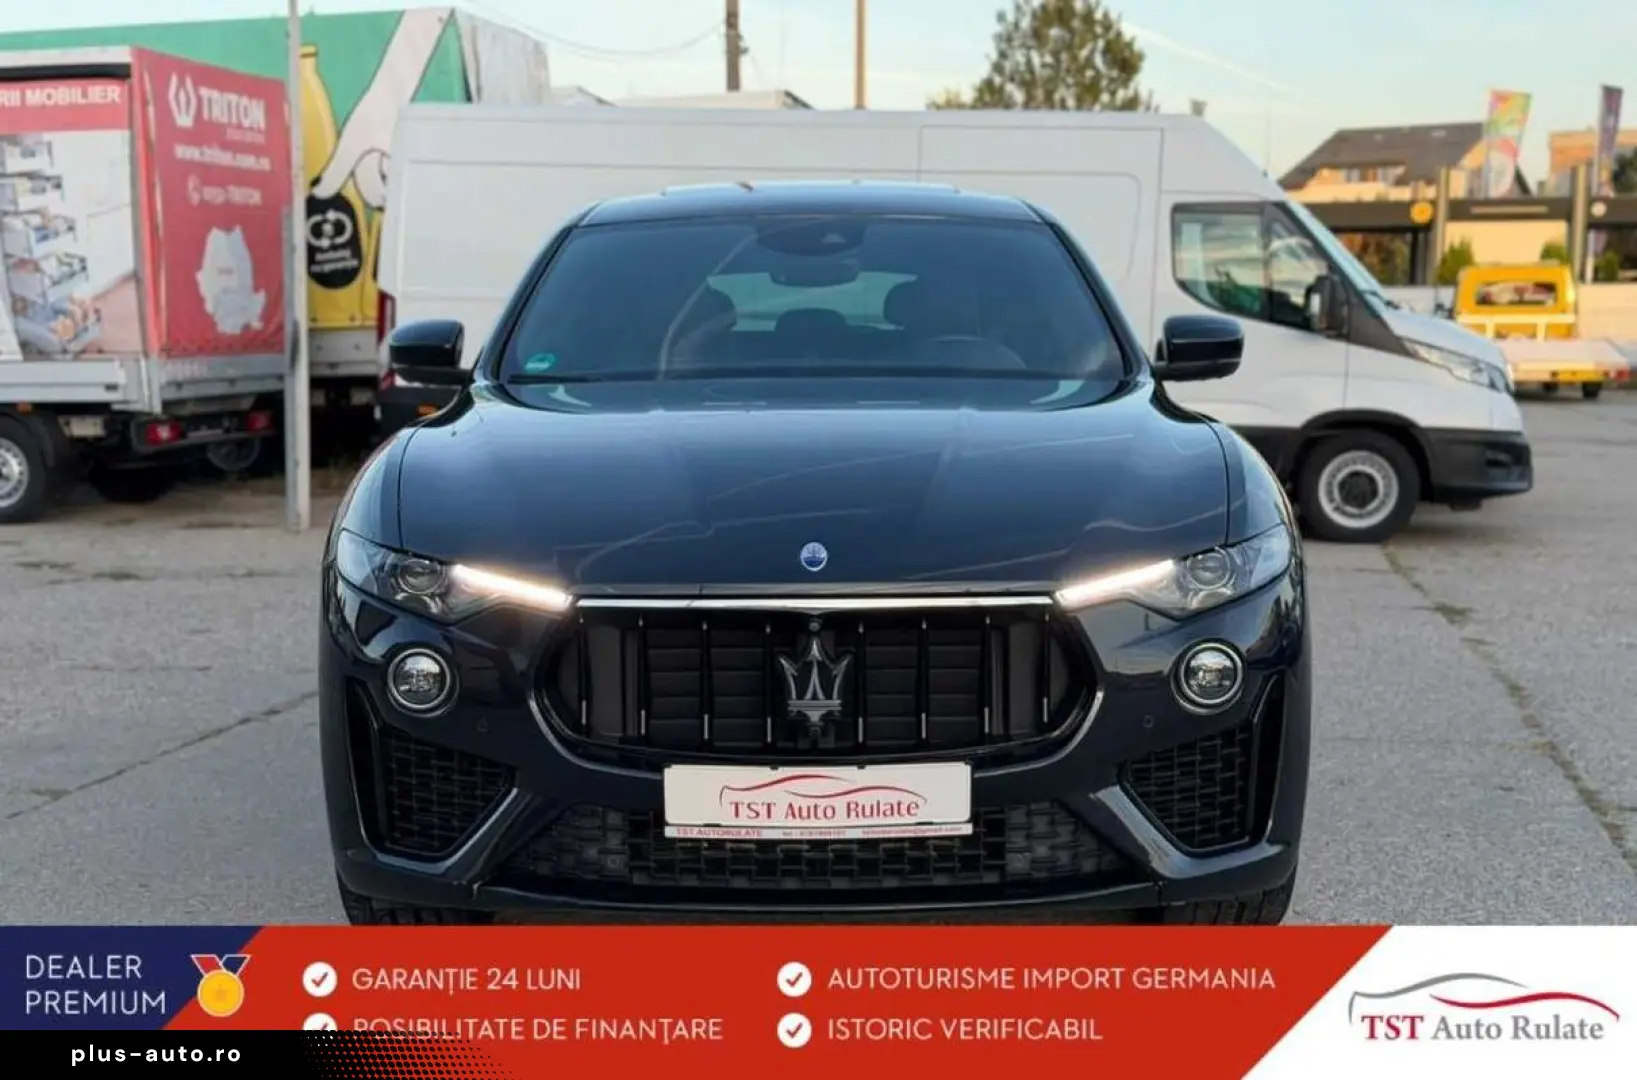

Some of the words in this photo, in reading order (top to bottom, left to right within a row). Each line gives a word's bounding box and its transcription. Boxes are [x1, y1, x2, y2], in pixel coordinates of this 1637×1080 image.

[25, 85, 120, 106] MOBILIER
[199, 86, 266, 130] TRITON
[730, 801, 776, 819] TST
[784, 801, 836, 820] Auto
[846, 799, 920, 820] Rulate
